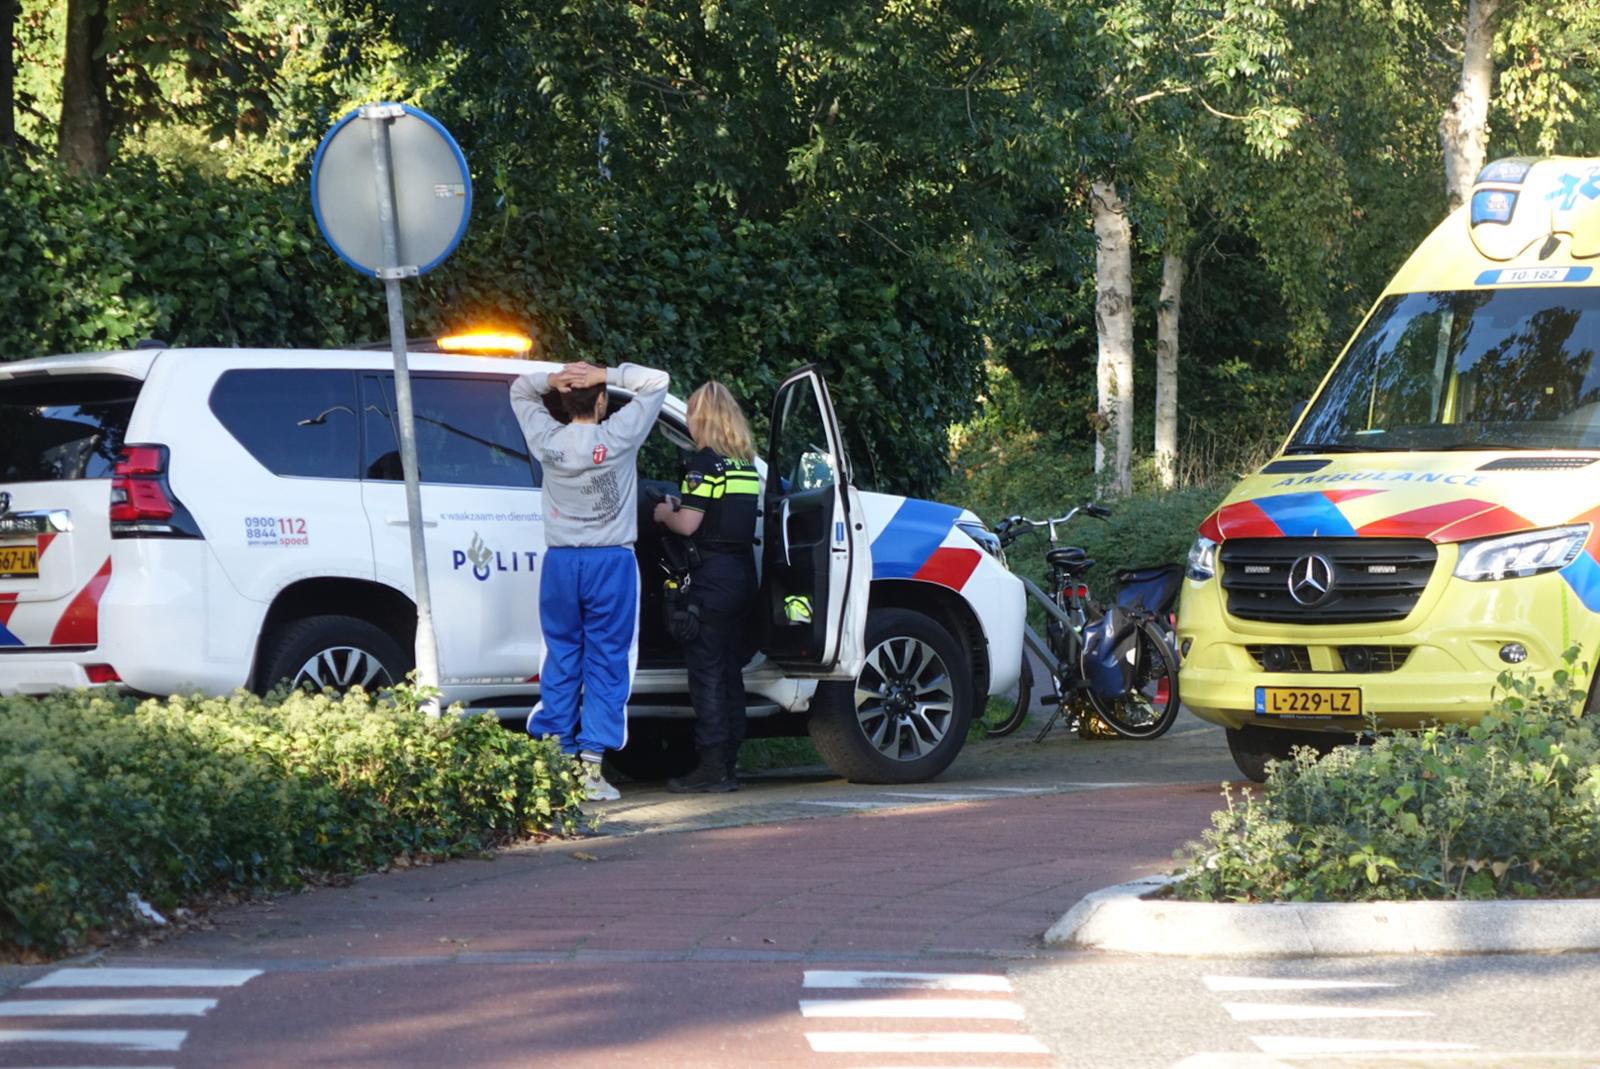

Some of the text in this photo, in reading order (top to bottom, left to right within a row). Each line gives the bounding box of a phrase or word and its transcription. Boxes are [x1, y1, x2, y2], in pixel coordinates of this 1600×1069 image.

[1511, 270, 1558, 281] 10-182
[1271, 472, 1488, 488] AMBULANCE
[495, 512, 506, 521] en
[245, 517, 275, 528] 0900
[278, 518, 306, 535] 112
[246, 528, 276, 538] 8844
[280, 536, 308, 547] spoed
[1273, 692, 1351, 712] L-229-LZ
